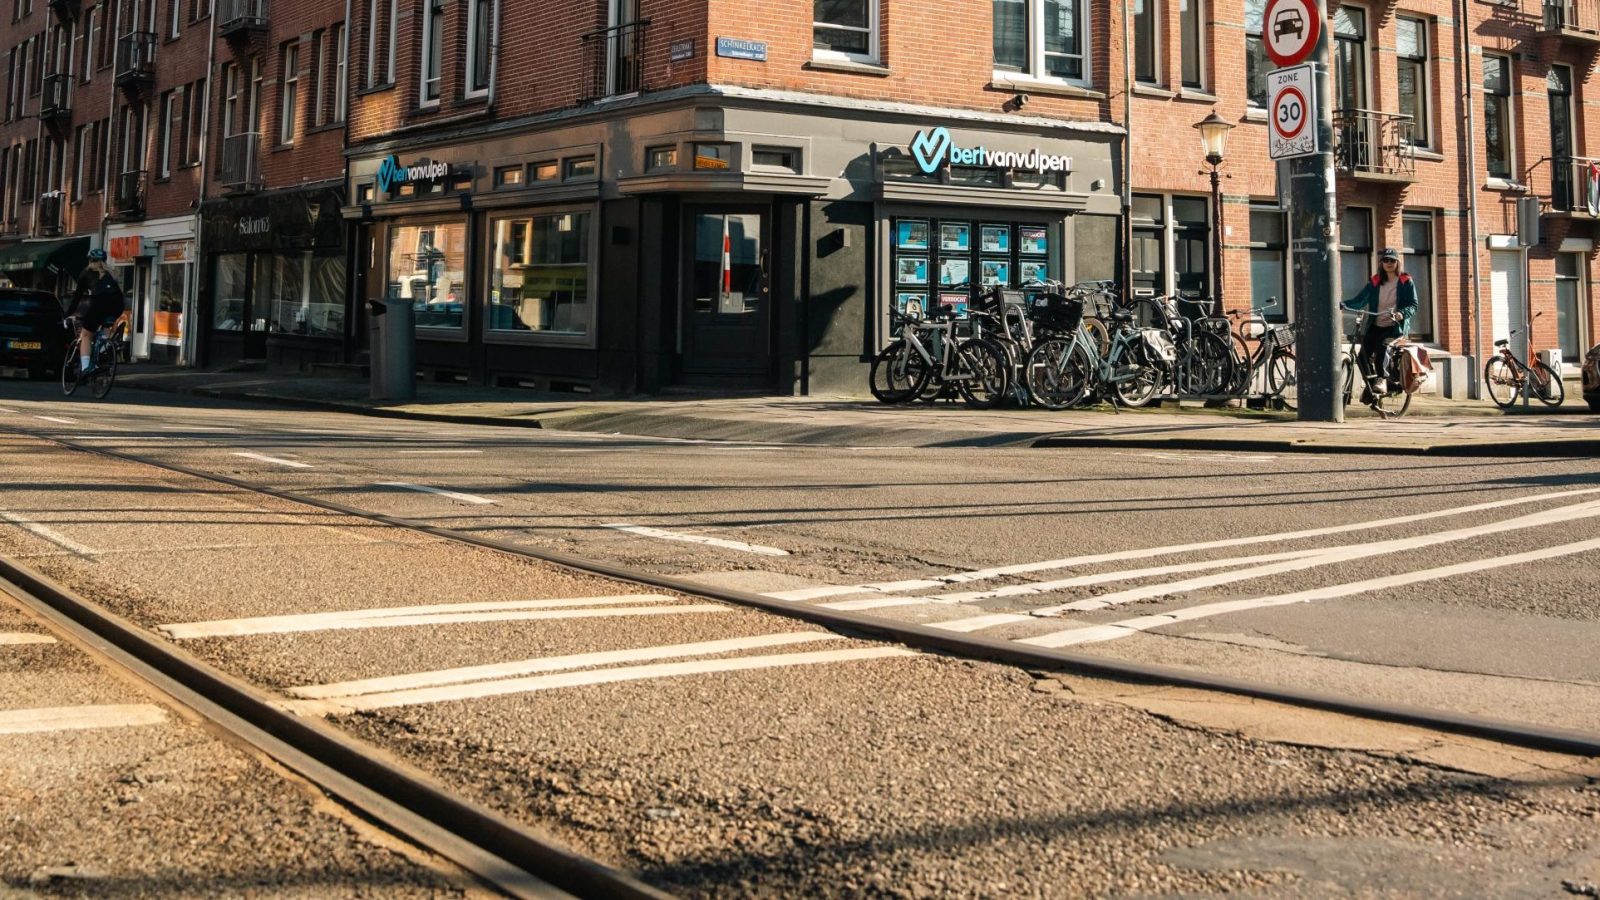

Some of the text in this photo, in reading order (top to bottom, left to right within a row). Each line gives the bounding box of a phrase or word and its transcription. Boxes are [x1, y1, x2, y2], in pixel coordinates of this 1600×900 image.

[1278, 73, 1299, 84] ZONE
[1279, 102, 1300, 123] 30
[950, 142, 1072, 174] bertvanvulpen
